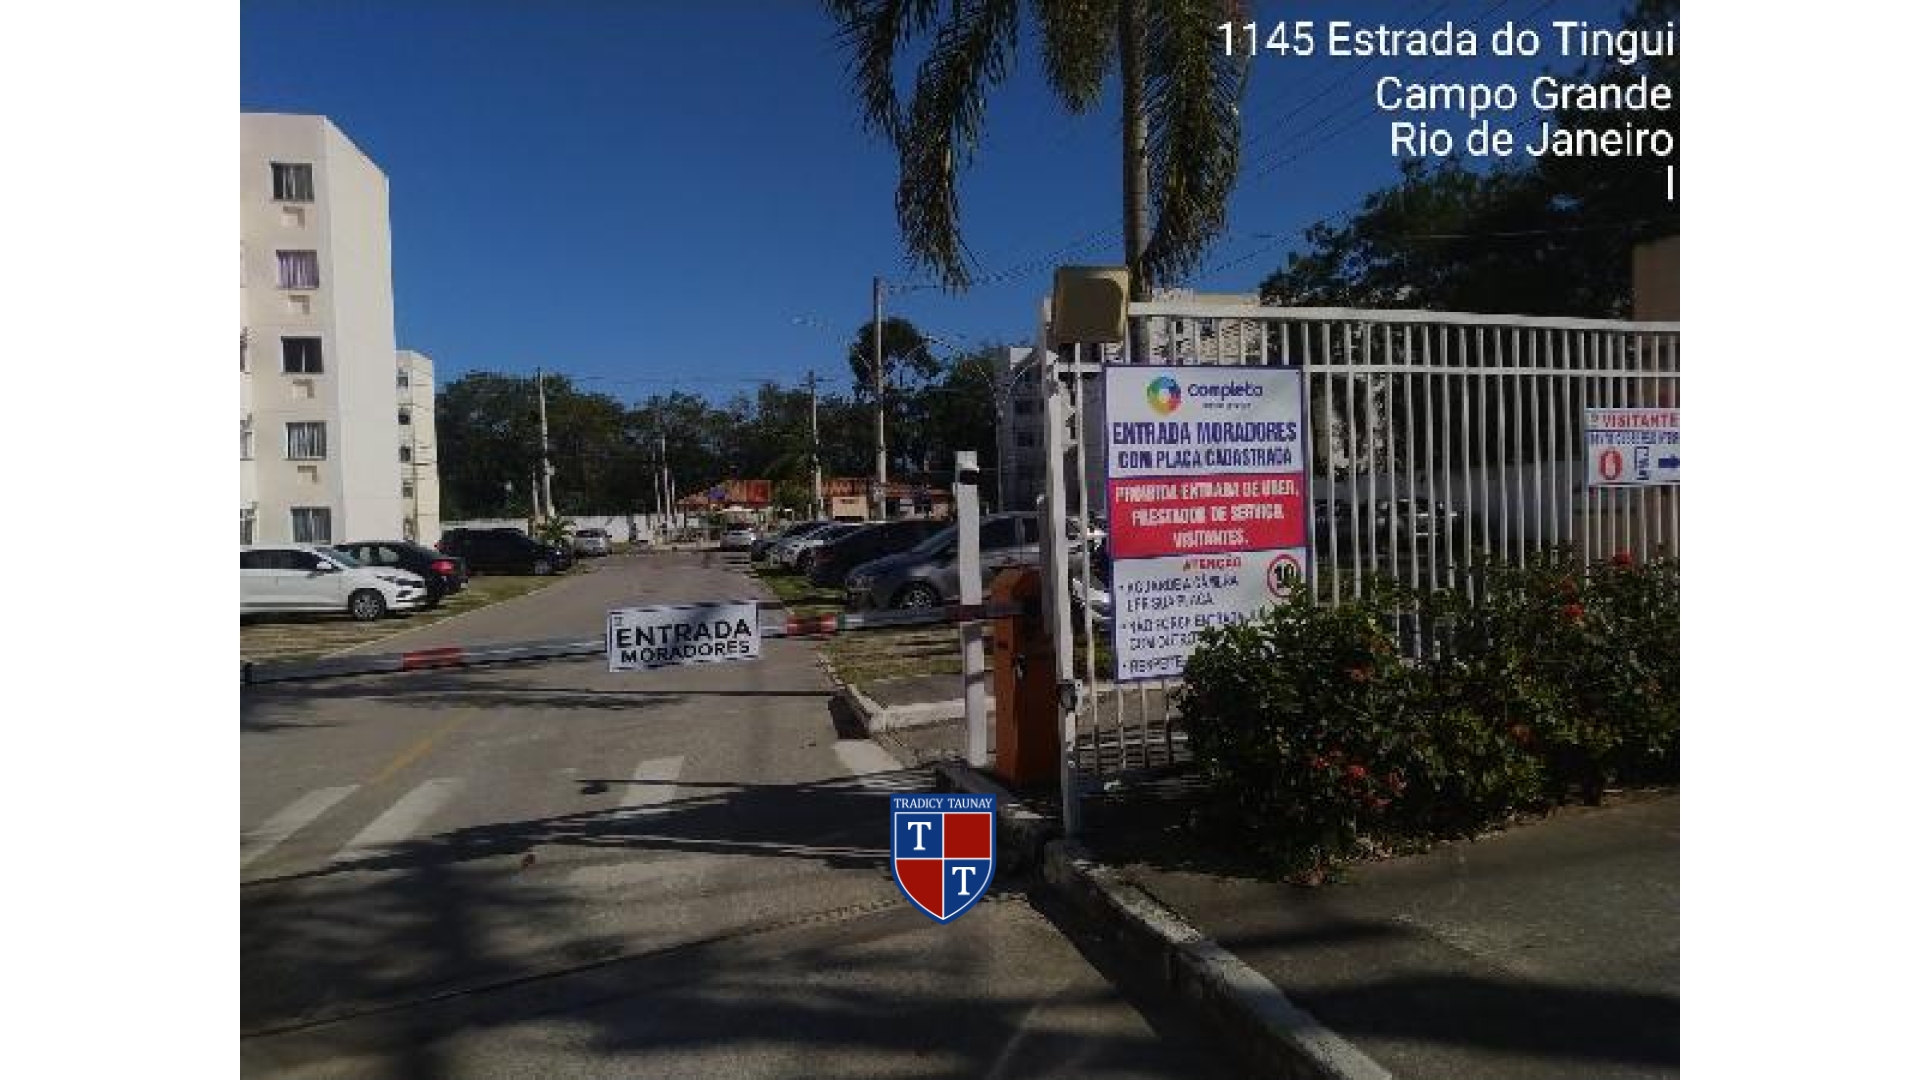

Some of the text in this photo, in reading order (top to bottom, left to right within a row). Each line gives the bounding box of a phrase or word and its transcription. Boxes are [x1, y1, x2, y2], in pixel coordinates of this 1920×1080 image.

[1113, 421, 1297, 444] ENTRADA MORADORES
[1118, 450, 1153, 469] COM
[1242, 480, 1260, 497] DE
[1211, 505, 1227, 522] DE
[616, 618, 752, 649] ENTRADA
[620, 640, 750, 663] MORADORES
